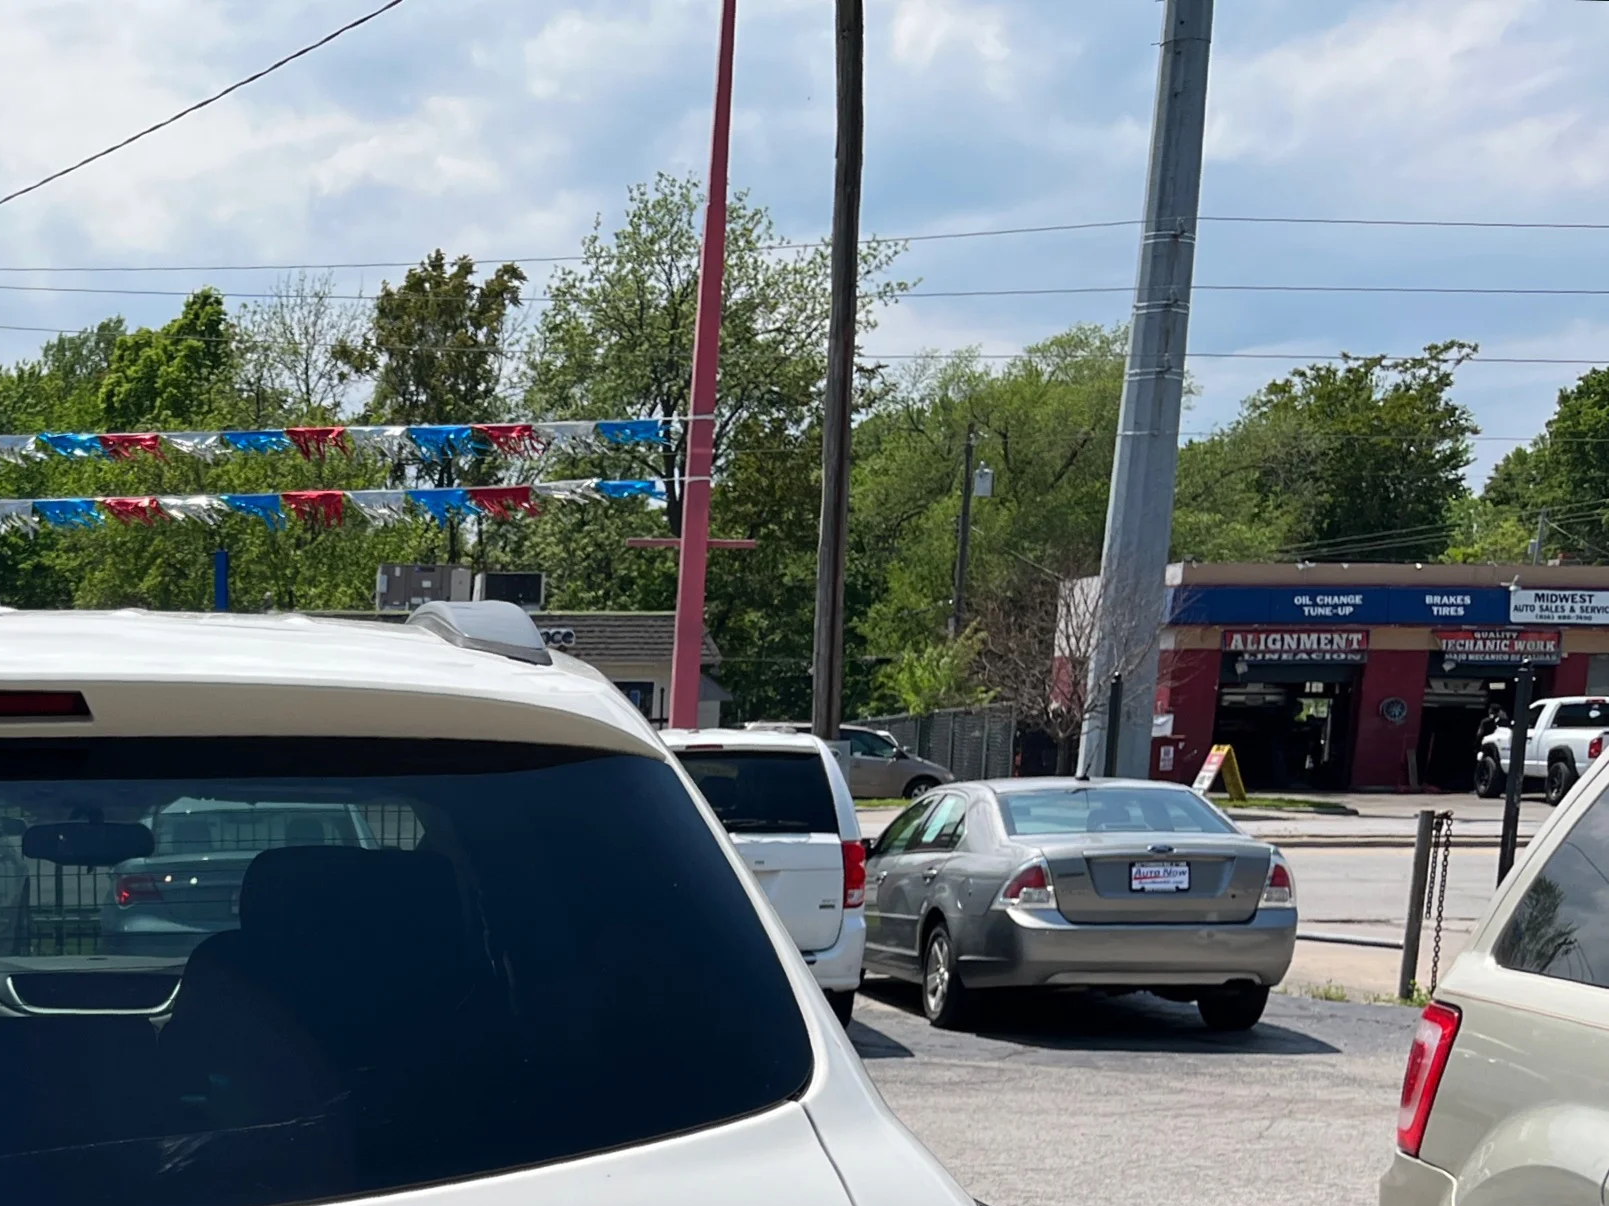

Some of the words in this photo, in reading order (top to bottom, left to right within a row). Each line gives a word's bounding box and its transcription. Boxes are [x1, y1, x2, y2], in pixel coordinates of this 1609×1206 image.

[1293, 595, 1313, 605] OIL
[1316, 594, 1363, 605] CHANGE
[1425, 594, 1471, 605] BRAKES
[1534, 593, 1595, 605] MIDWEST
[1303, 606, 1354, 616] TUNE-UP
[1432, 606, 1465, 616] TIRES
[1512, 604, 1536, 613] AUTO
[1539, 605, 1566, 613] SALES
[1569, 605, 1576, 613] &
[1474, 631, 1519, 639] QUALITY
[1230, 633, 1363, 650] ALIGNMENT
[1513, 640, 1556, 652] WORK
[1238, 651, 1362, 661] LINEACION
